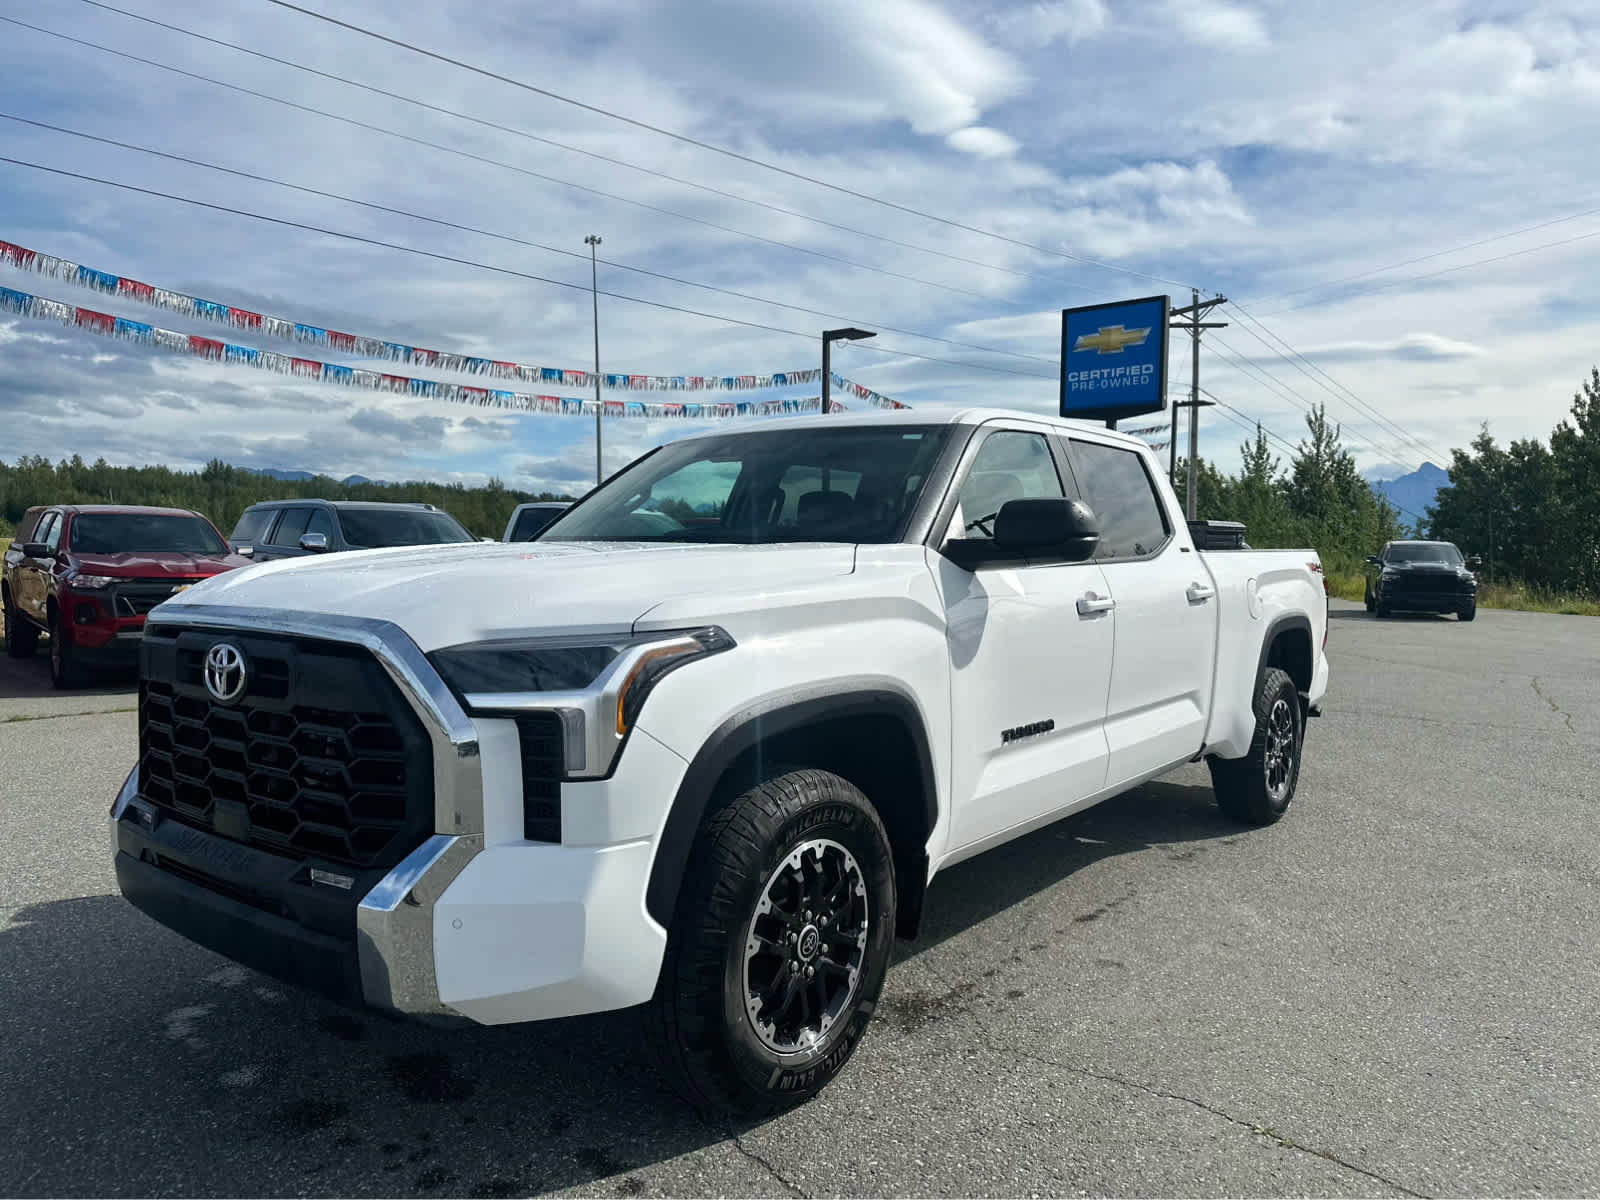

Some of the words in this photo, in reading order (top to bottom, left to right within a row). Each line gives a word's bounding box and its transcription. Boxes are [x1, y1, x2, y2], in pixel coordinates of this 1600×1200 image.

[1068, 364, 1154, 382] CERTIFIED
[1072, 375, 1150, 392] PRE-OWNED
[785, 808, 855, 844] MICHELIN
